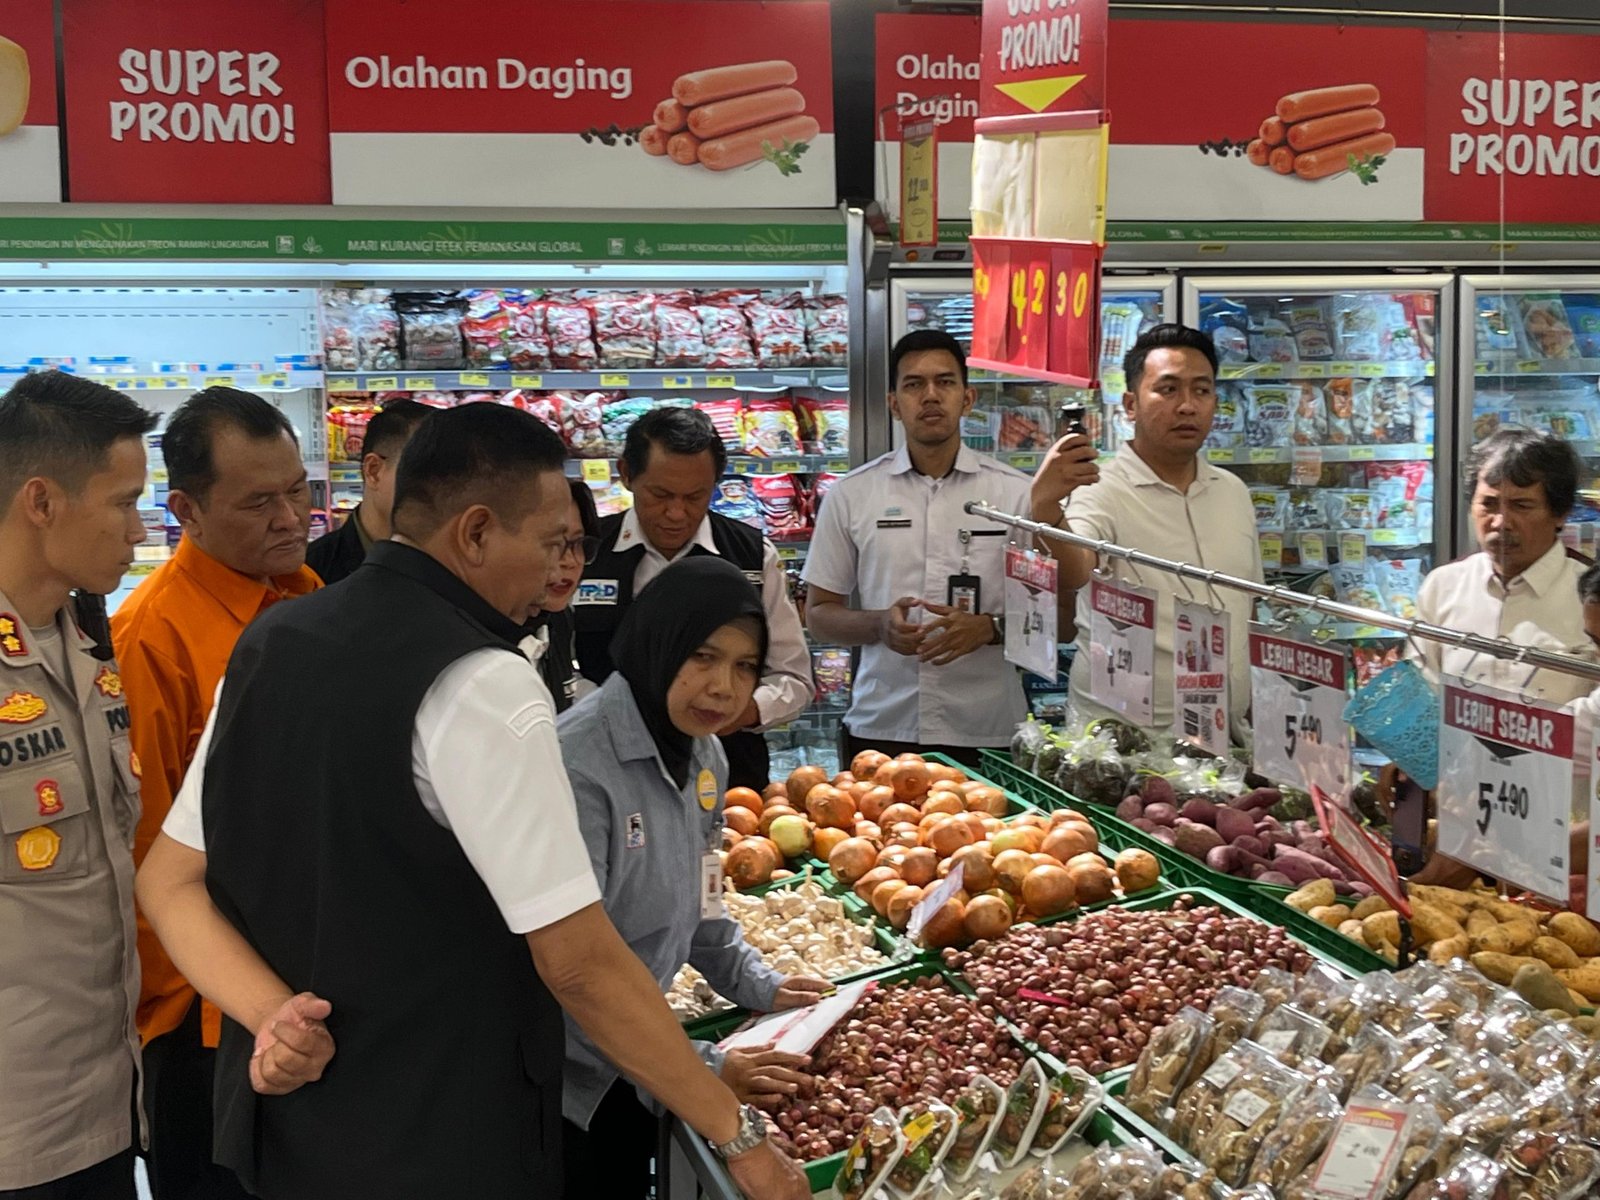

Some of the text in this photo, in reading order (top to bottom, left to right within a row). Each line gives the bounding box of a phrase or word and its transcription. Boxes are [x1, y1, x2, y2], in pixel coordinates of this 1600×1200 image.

[1001, 13, 1080, 71] PROMO!
[119, 48, 283, 97] SUPER
[345, 55, 632, 99] Olahan Daging
[109, 101, 296, 144] PROMO!
[1449, 132, 1600, 176] PROMO
[347, 240, 379, 251] MARI
[1260, 641, 1334, 684] LEBIH SEGAR
[1454, 695, 1554, 750] LEBIH SEGAR
[0, 727, 66, 767] OSKAR
